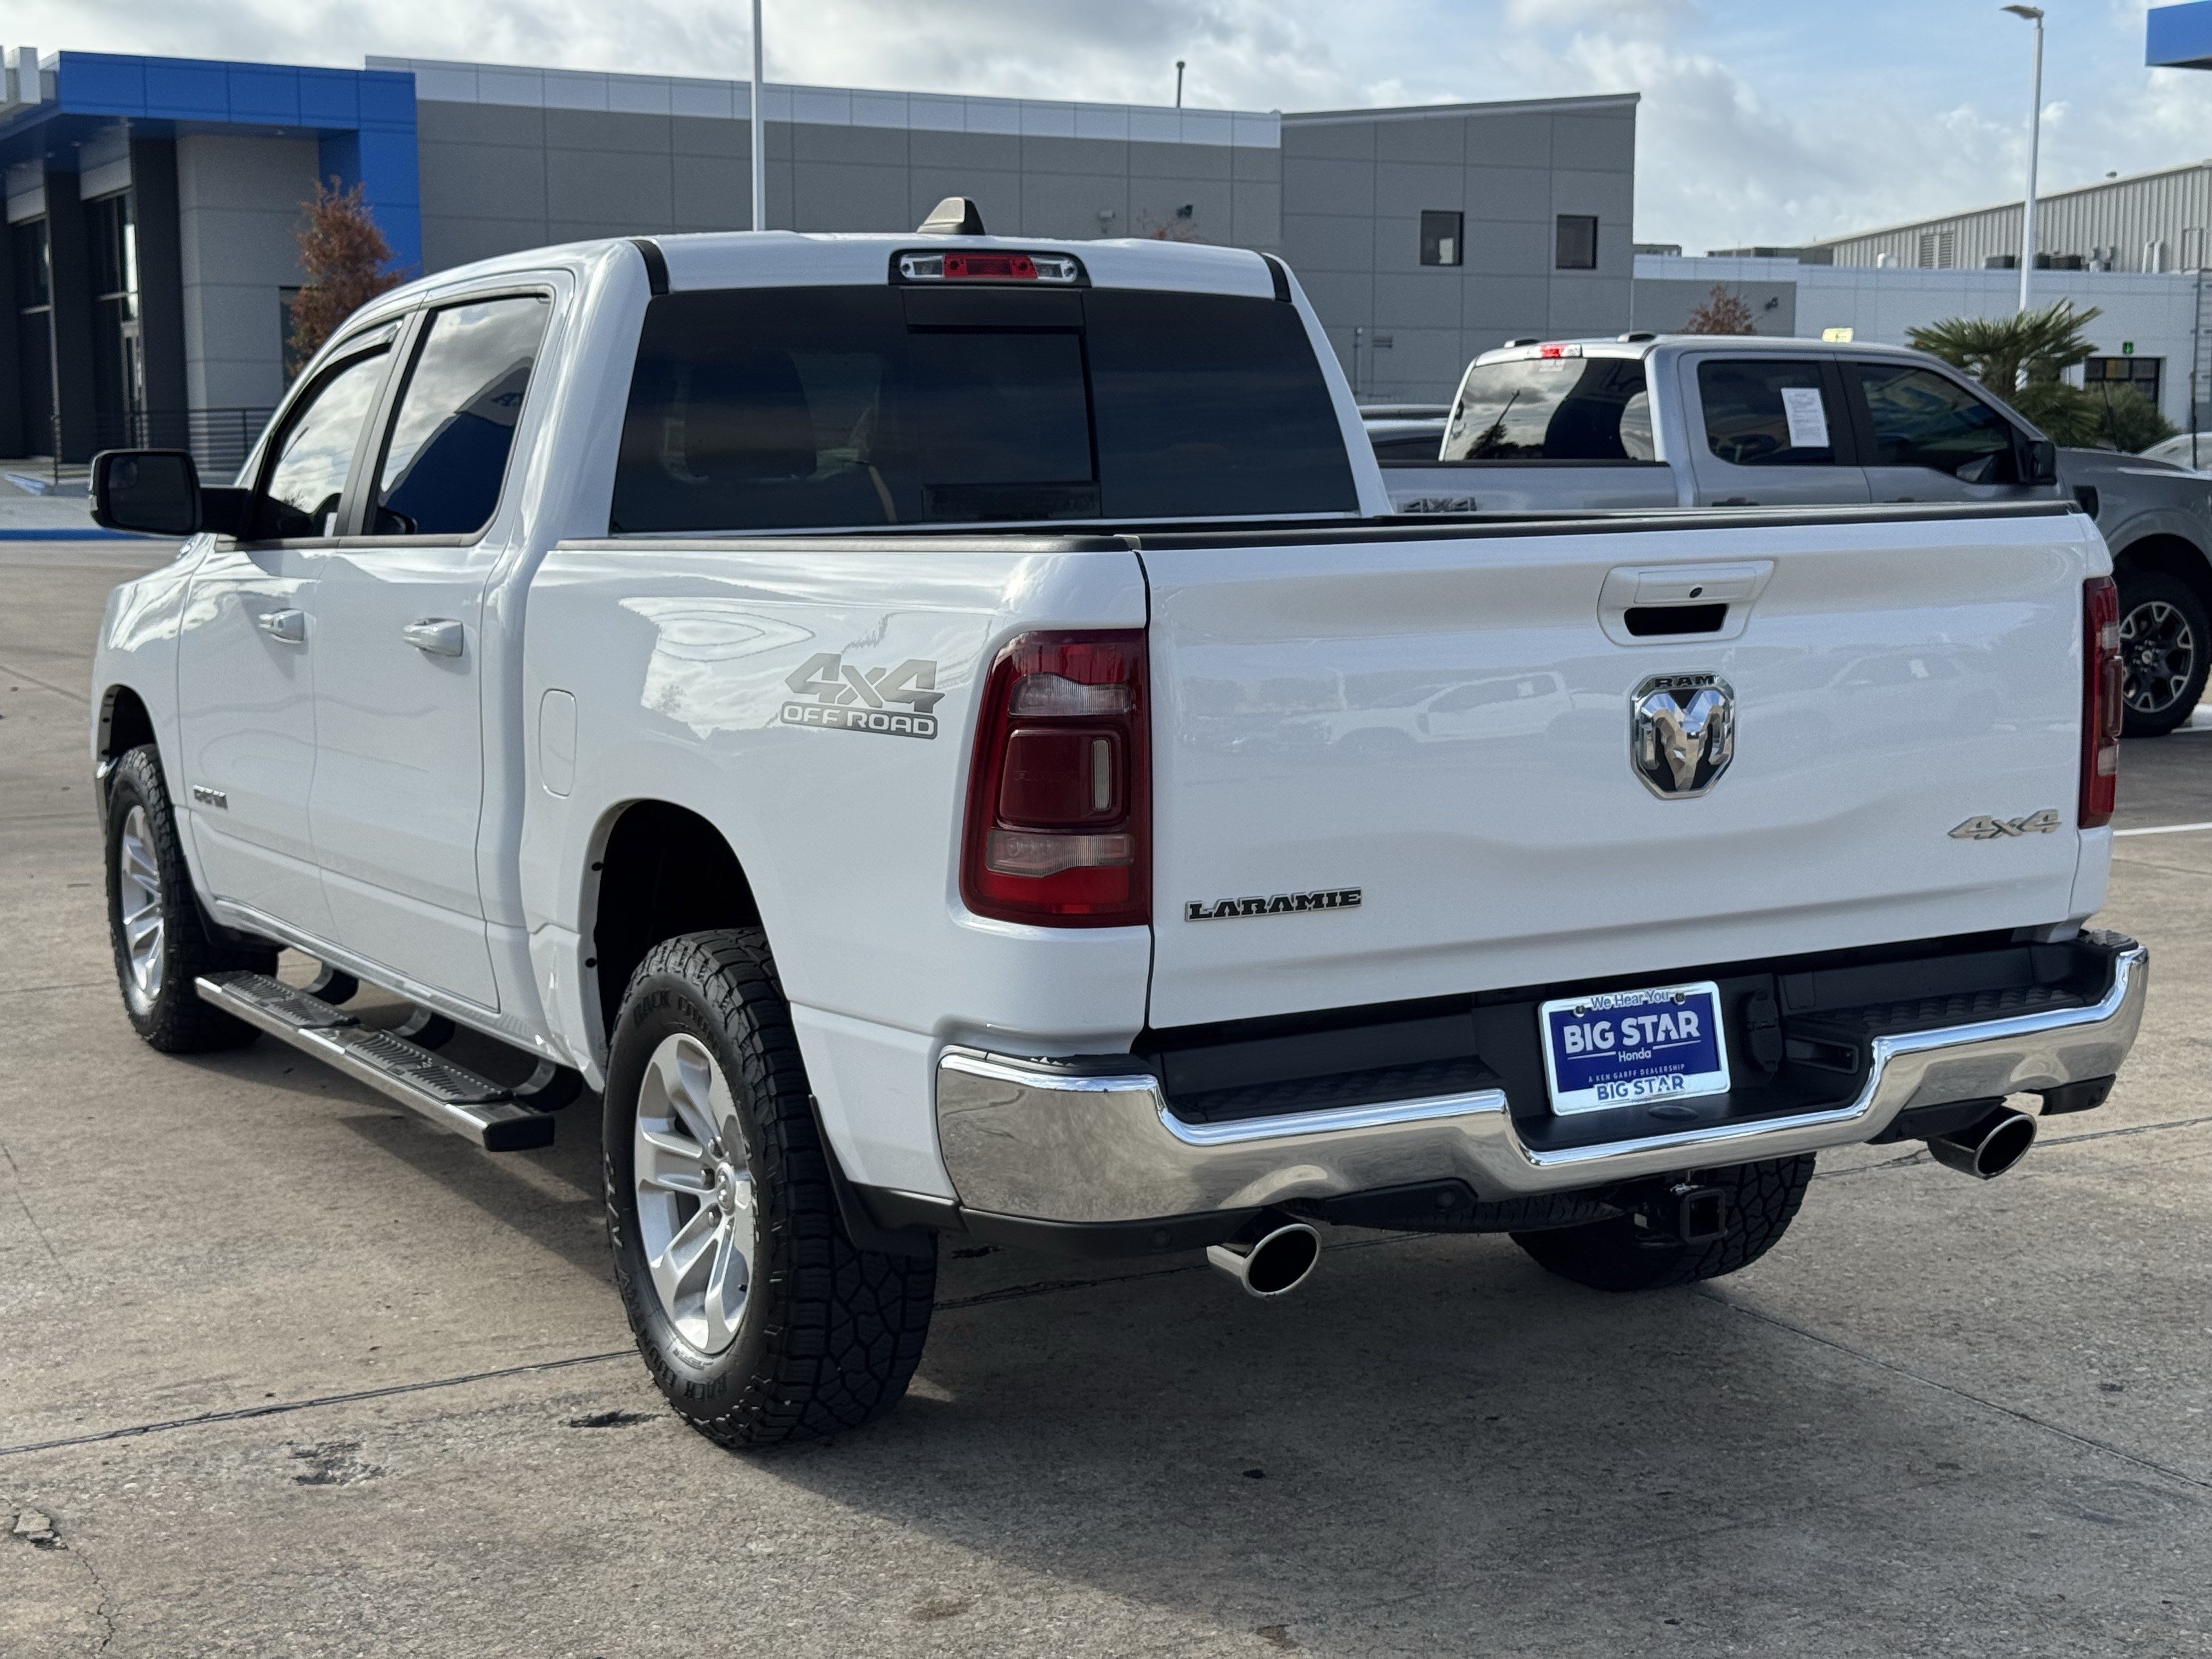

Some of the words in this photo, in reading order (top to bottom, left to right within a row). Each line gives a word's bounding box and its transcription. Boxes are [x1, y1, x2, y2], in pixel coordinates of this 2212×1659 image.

[1654, 674, 1720, 687] RAM
[783, 705, 841, 724] OFF
[847, 710, 934, 735] ROAD
[1186, 887, 1362, 921] LARAMIE
[1591, 997, 1611, 1010] We
[1615, 991, 1643, 1007] Hear
[1646, 989, 1669, 1003] You
[1564, 1021, 1615, 1054] BIG
[1621, 1011, 1701, 1046] STAR
[1618, 1047, 1652, 1063] Honda
[1595, 1073, 1611, 1082] KEN
[1613, 1069, 1637, 1080] GARFF
[1640, 1063, 1685, 1076] DEALERSHIP
[1596, 1082, 1628, 1101] BIG
[1633, 1074, 1685, 1095] STAR
